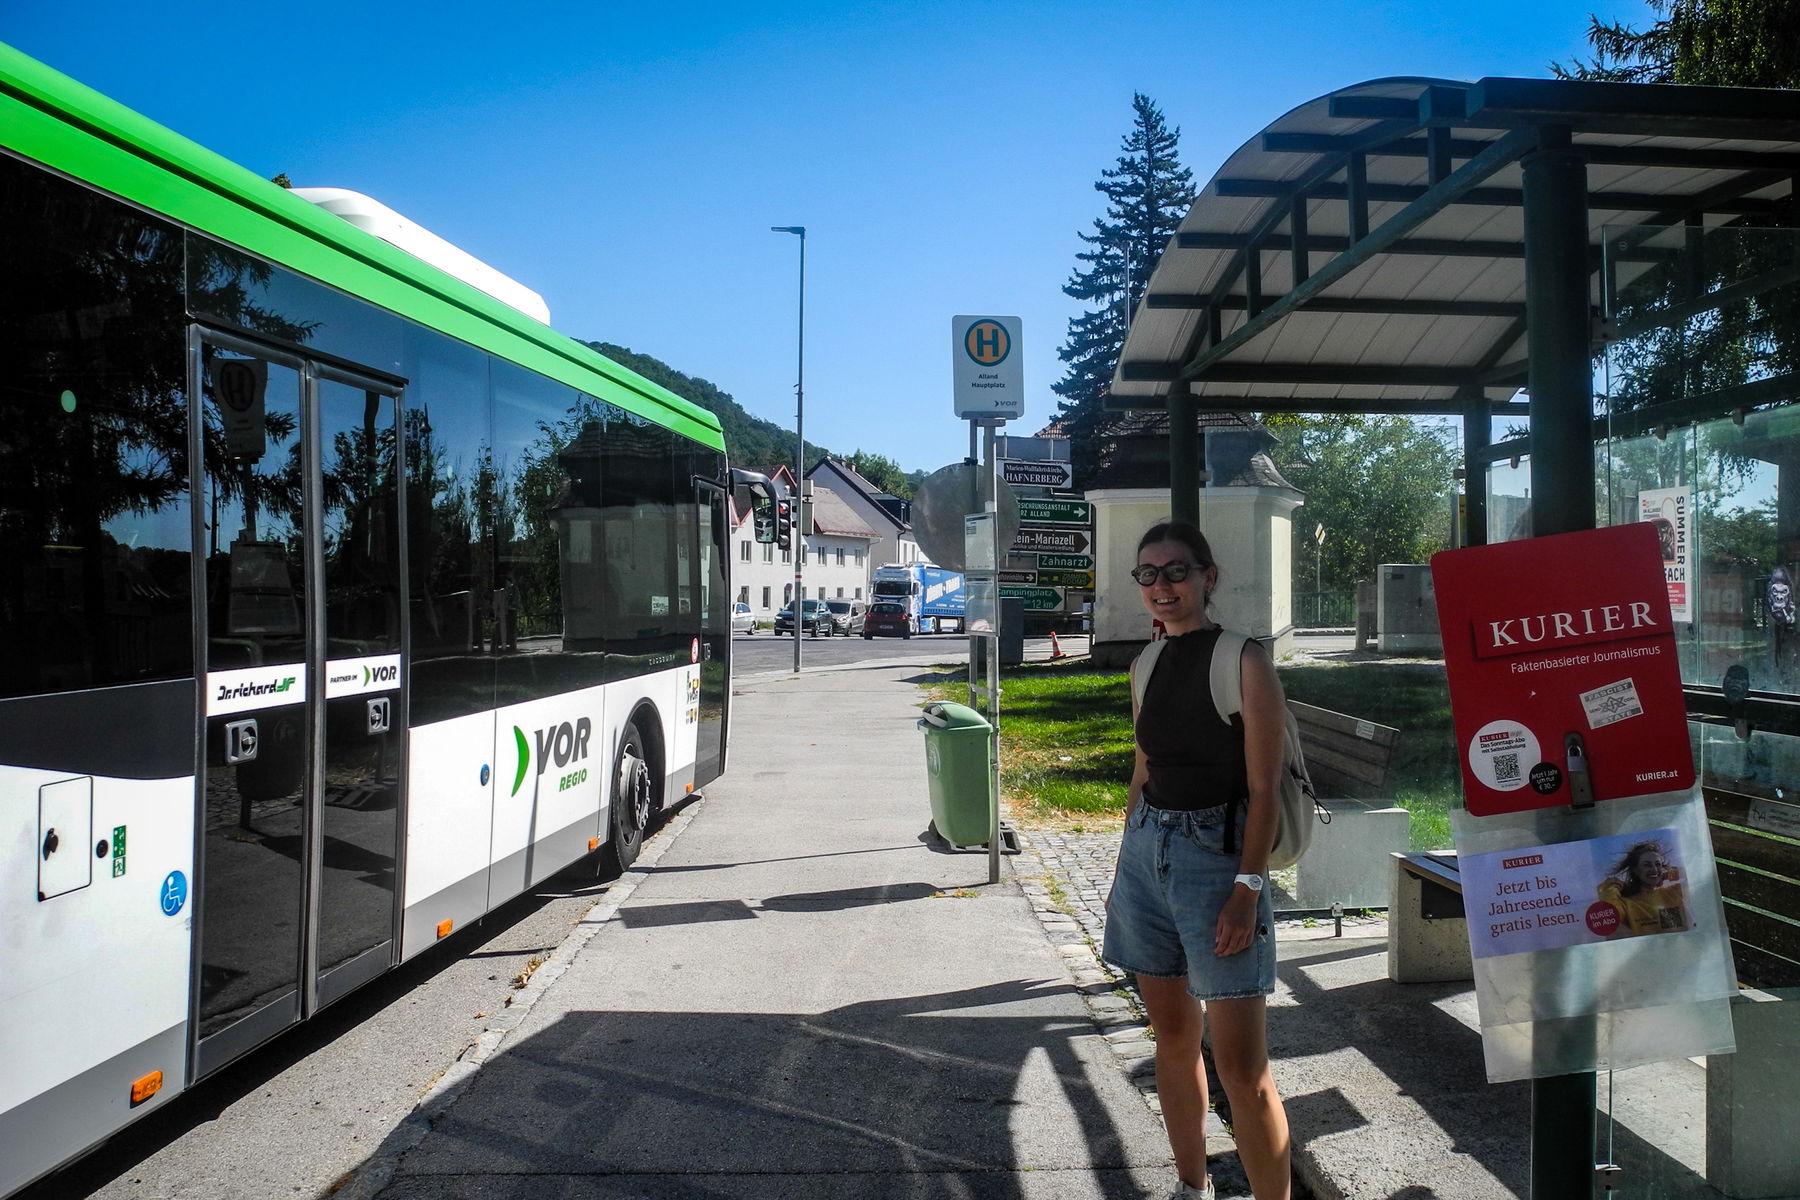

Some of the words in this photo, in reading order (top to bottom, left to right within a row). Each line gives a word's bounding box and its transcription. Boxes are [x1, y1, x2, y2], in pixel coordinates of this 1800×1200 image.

[977, 328, 999, 357] H
[971, 381, 1006, 389] Hauptplatz
[1006, 473, 1063, 484] HAFNERBERG
[1030, 510, 1050, 518] ALLAND
[1676, 496, 1685, 565] SUMMER
[1041, 555, 1088, 567] Zahnarzt
[1032, 599, 1042, 609] 12
[1043, 600, 1054, 609] km
[1489, 602, 1658, 648] KURIER
[1511, 655, 1590, 674] Faktenbasierter
[1593, 645, 1661, 662] Journalismus
[330, 675, 351, 684] PARTNER
[372, 666, 397, 682] VOR
[1481, 732, 1508, 742] KURIER
[534, 716, 591, 776] VOR
[559, 768, 588, 792] REGIO
[1635, 770, 1679, 782] KURIER.at
[1505, 856, 1542, 868] KURIER
[1496, 880, 1531, 896] Jetzt
[1536, 875, 1557, 890] bis
[1488, 892, 1572, 916] Jahresende
[1589, 909, 1615, 921] KURIER
[1490, 917, 1532, 938] gratis
[1537, 912, 1580, 928] lesen.
[1592, 920, 1602, 928] im
[1602, 918, 1616, 927] Abo
